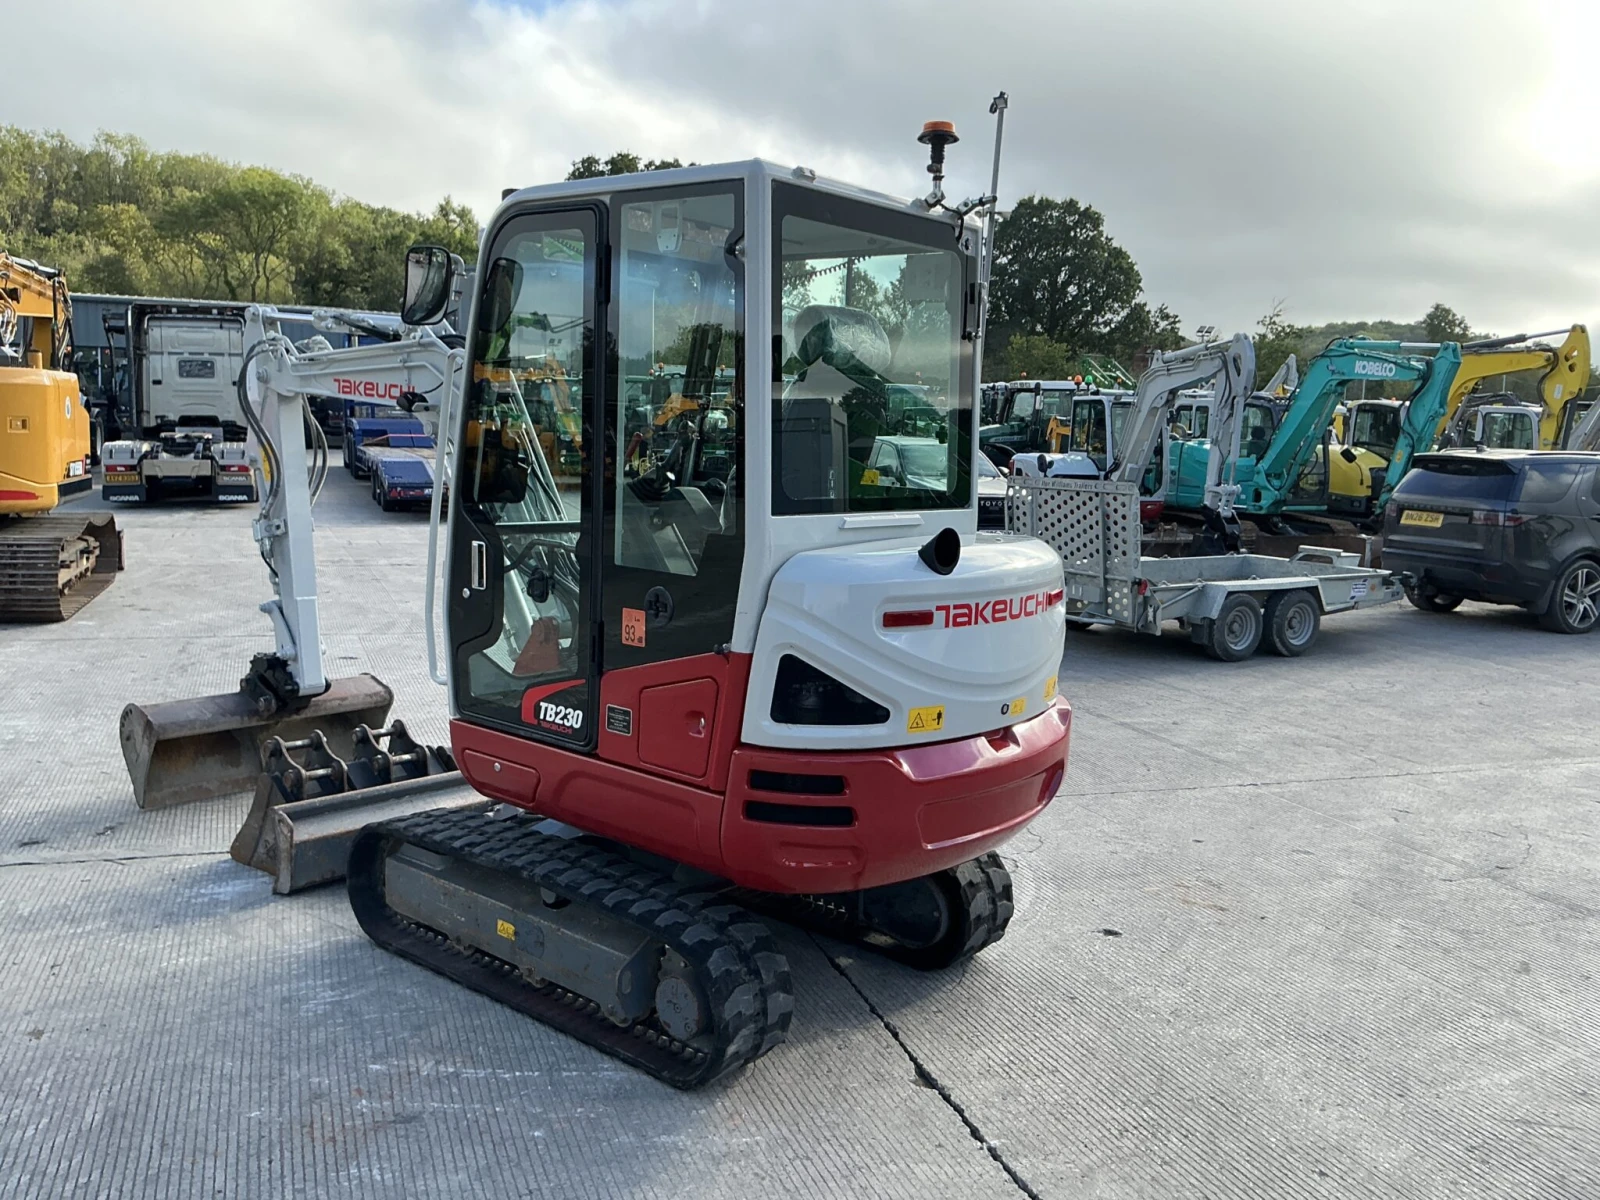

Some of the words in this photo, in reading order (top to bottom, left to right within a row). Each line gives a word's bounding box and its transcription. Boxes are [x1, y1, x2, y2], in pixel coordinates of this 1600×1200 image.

[1355, 360, 1396, 377] KOBELCO
[935, 590, 1048, 628] TAKEUCHI
[625, 624, 636, 643] 93
[539, 701, 583, 729] TB230
